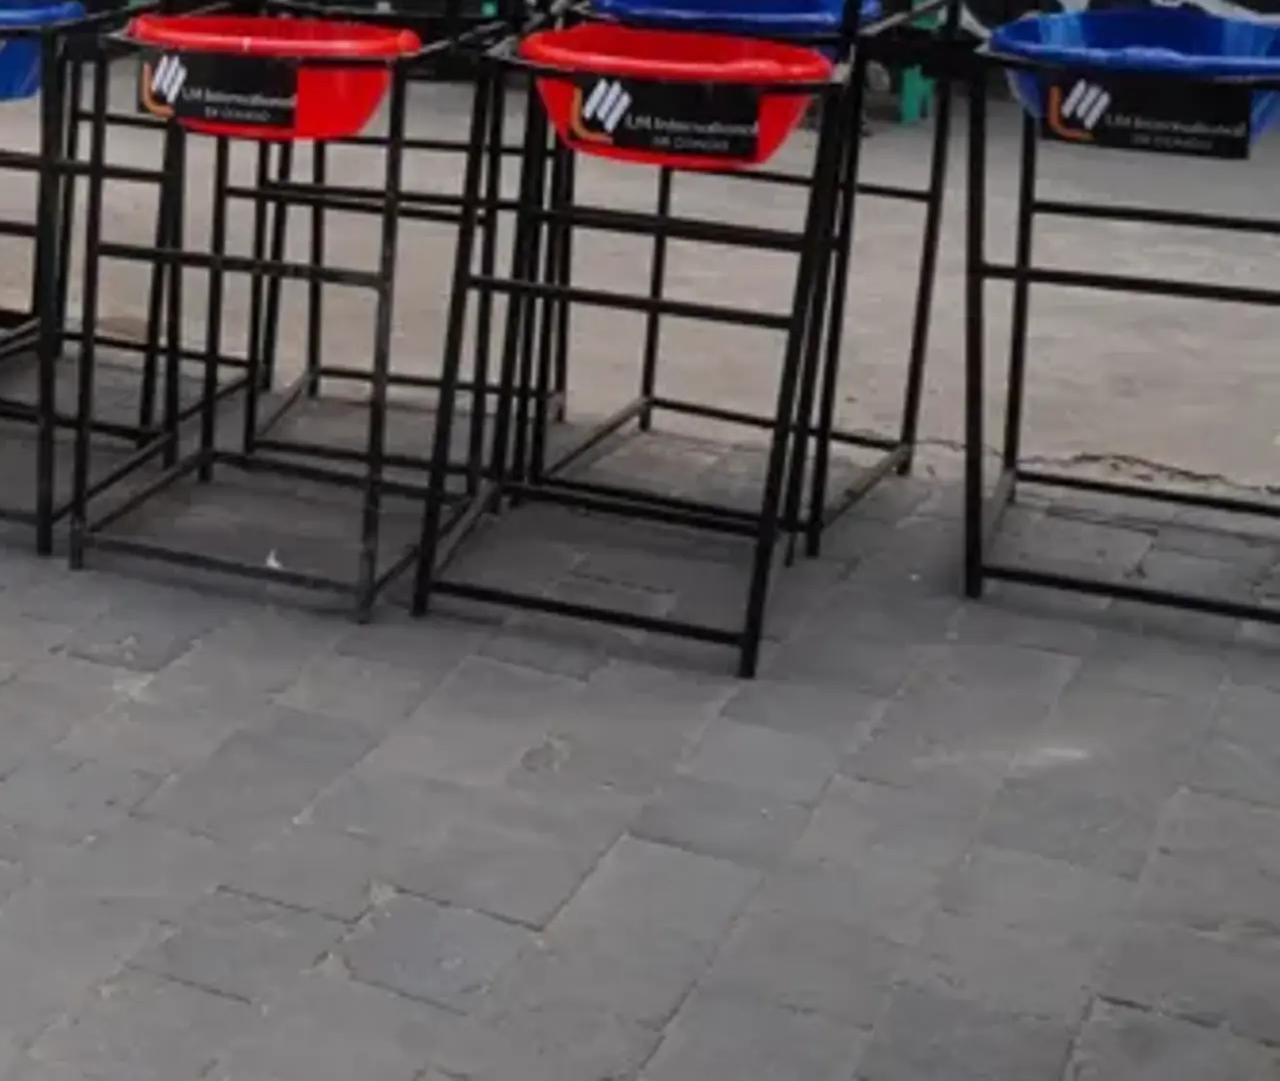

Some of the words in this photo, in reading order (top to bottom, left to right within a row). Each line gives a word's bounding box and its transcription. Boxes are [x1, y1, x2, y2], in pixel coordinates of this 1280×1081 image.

[205, 88, 299, 109] International
[625, 113, 651, 131] LM
[654, 117, 759, 137] International
[1134, 116, 1247, 138] International
